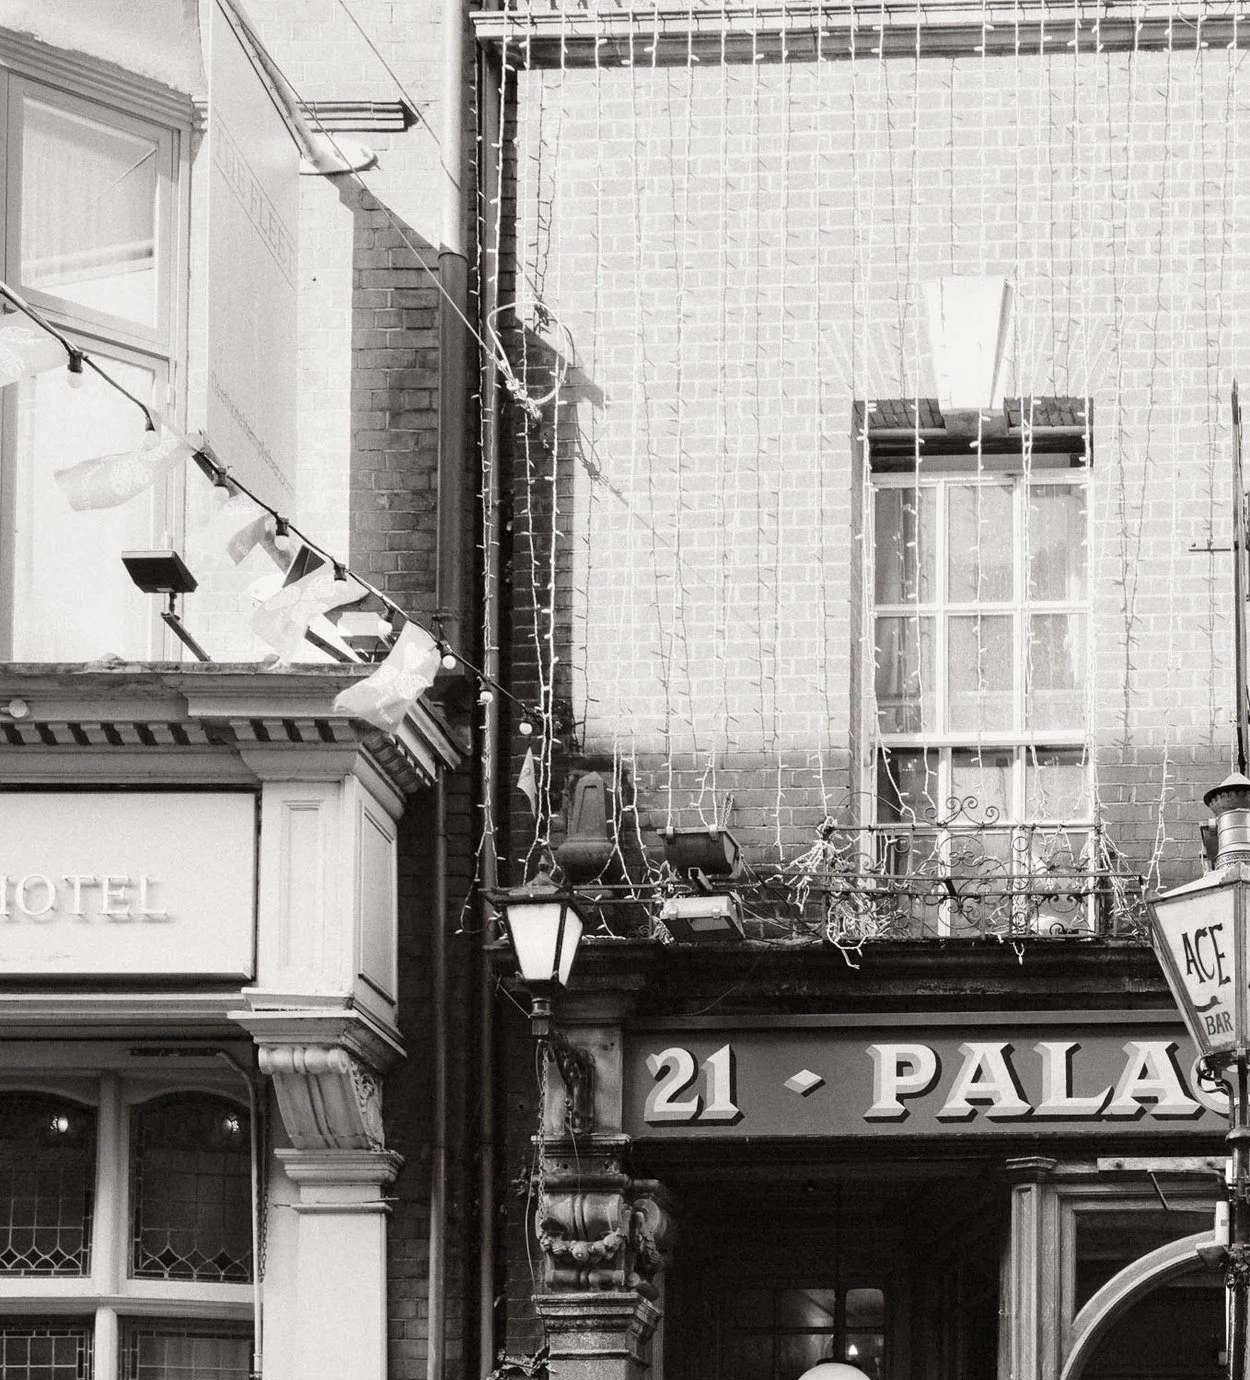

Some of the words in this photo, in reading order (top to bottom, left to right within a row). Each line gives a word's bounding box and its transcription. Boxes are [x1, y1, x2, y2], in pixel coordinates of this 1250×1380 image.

[1181, 922, 1231, 987] ACE
[1204, 1011, 1233, 1036] BAR
[644, 1043, 743, 1126] 21
